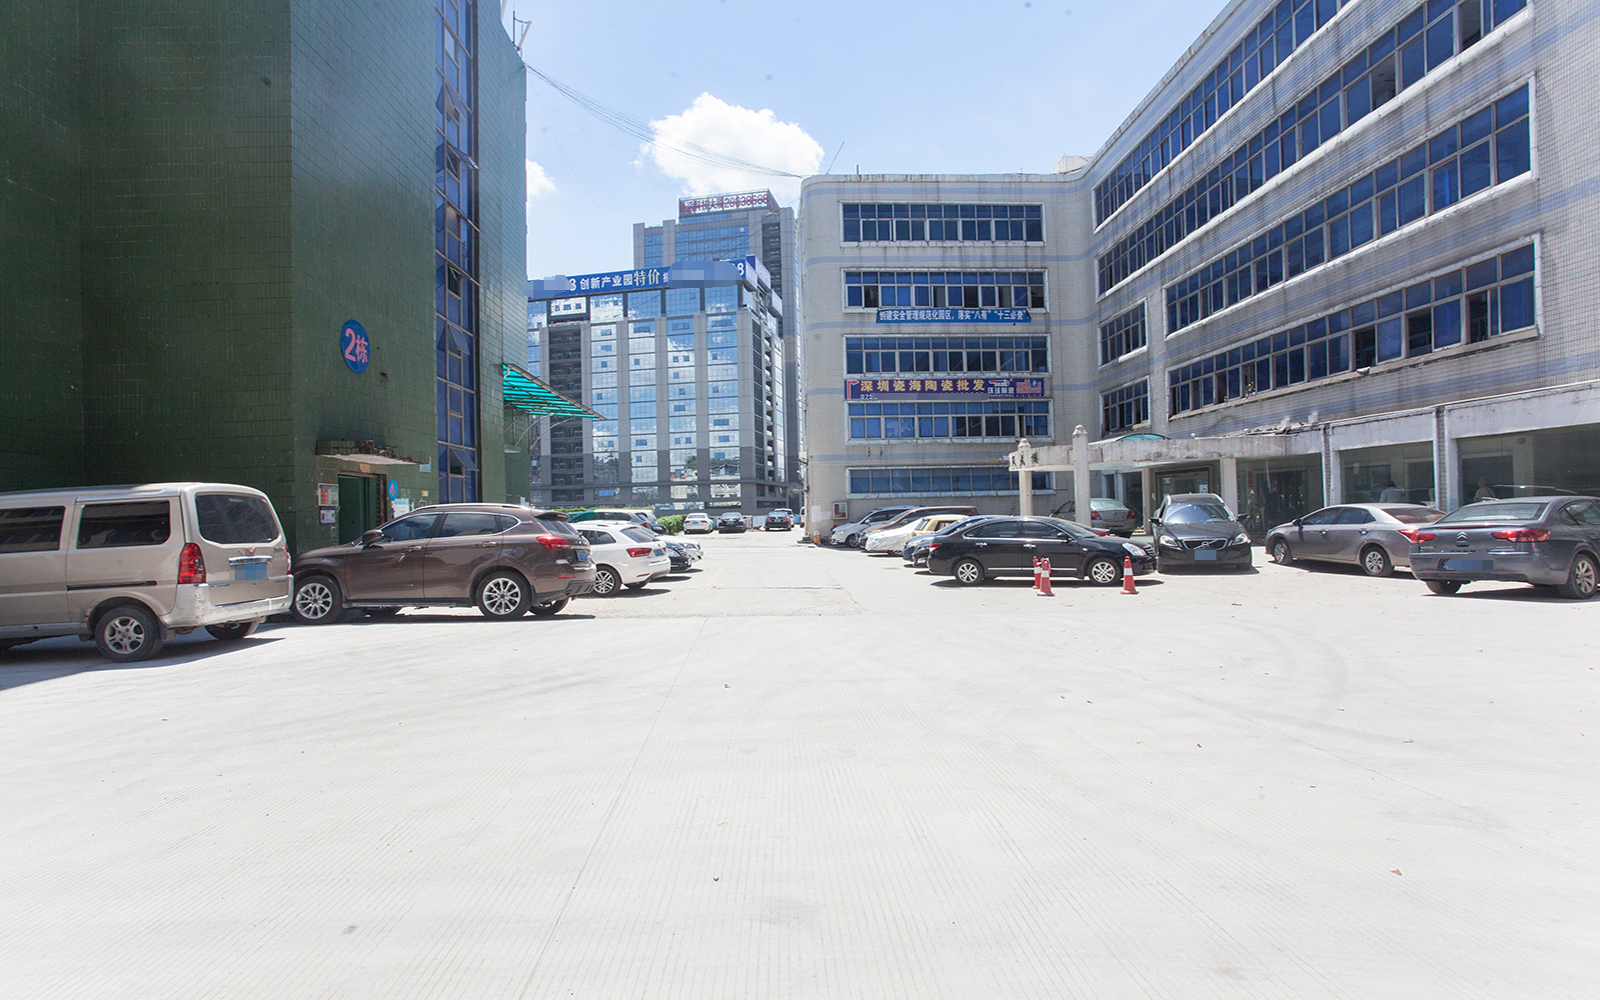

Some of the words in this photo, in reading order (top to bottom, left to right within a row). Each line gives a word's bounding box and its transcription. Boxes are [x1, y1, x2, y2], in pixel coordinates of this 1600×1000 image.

[345, 328, 368, 363] 2栋
[860, 379, 985, 392] 深圳瓷海陶瓷批发
